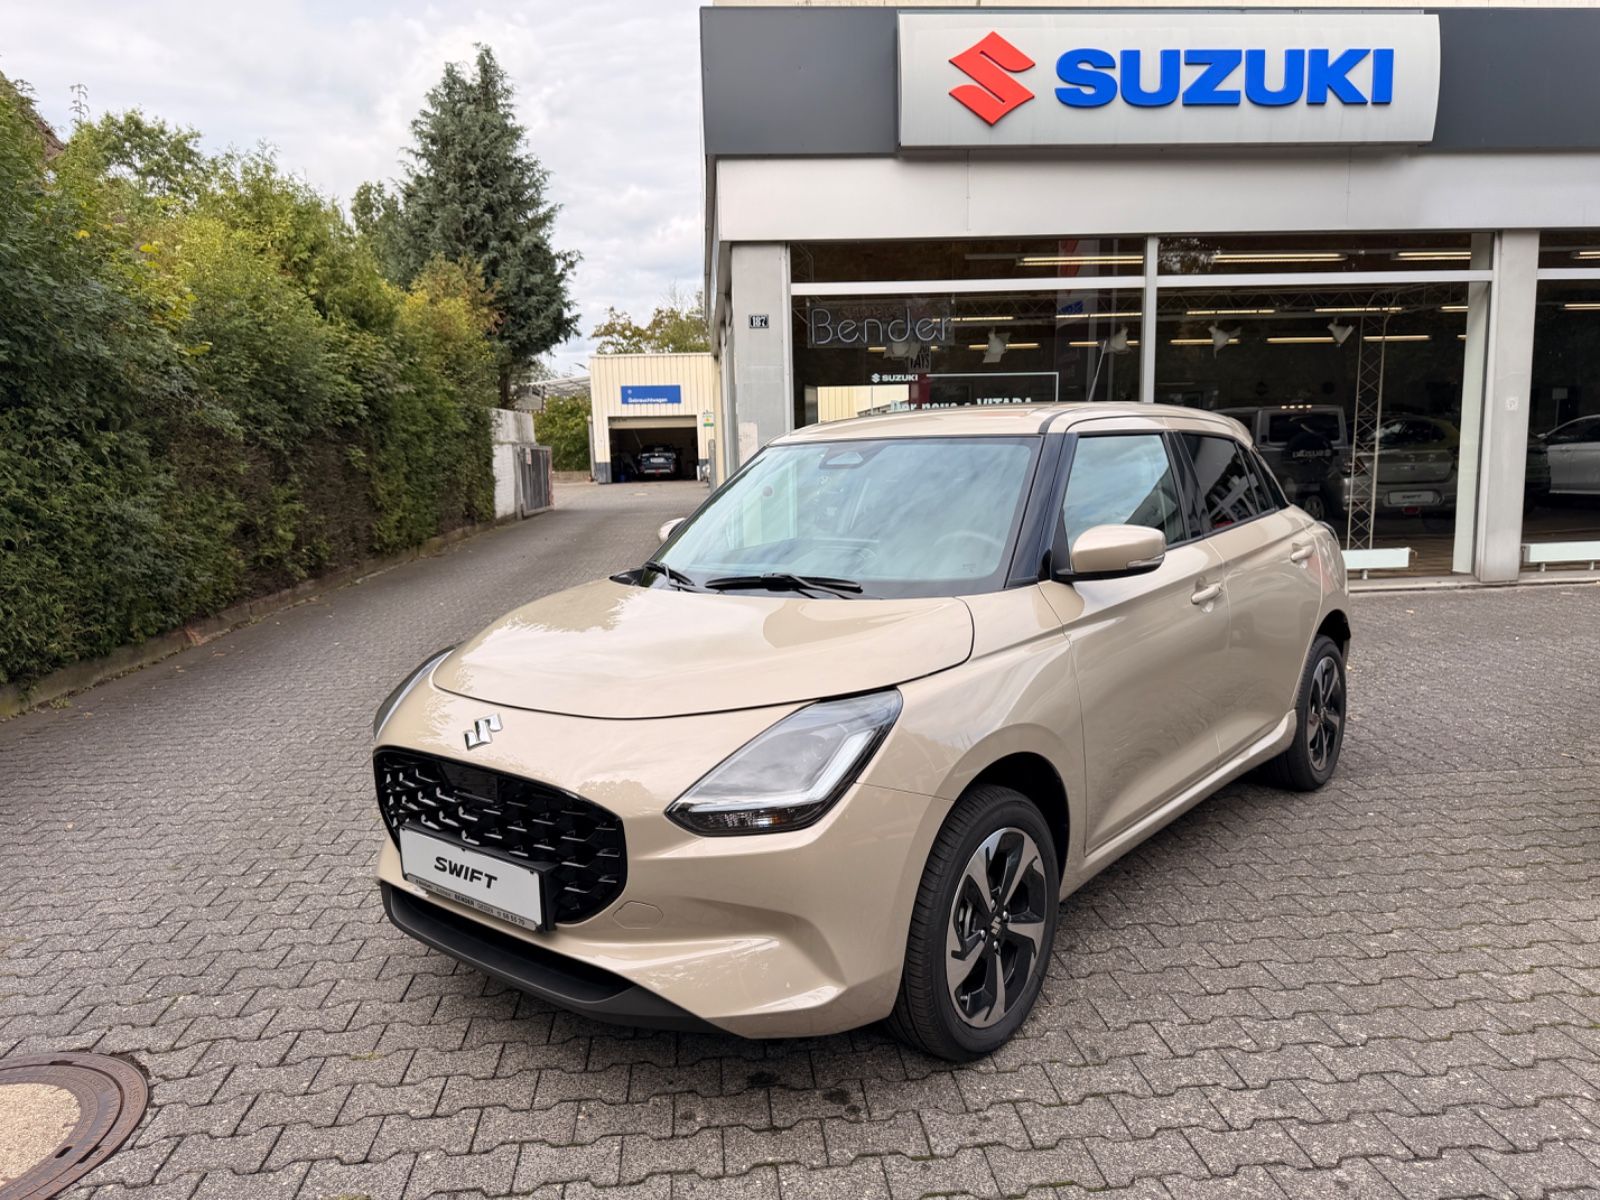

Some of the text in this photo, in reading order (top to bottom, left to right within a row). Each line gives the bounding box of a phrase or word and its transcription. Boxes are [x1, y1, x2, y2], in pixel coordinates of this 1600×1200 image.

[1054, 47, 1395, 108] SUZUKI
[751, 315, 767, 328] 187
[811, 306, 951, 344] Bender
[882, 374, 919, 382] SUZUKI
[434, 856, 498, 889] SWIFT
